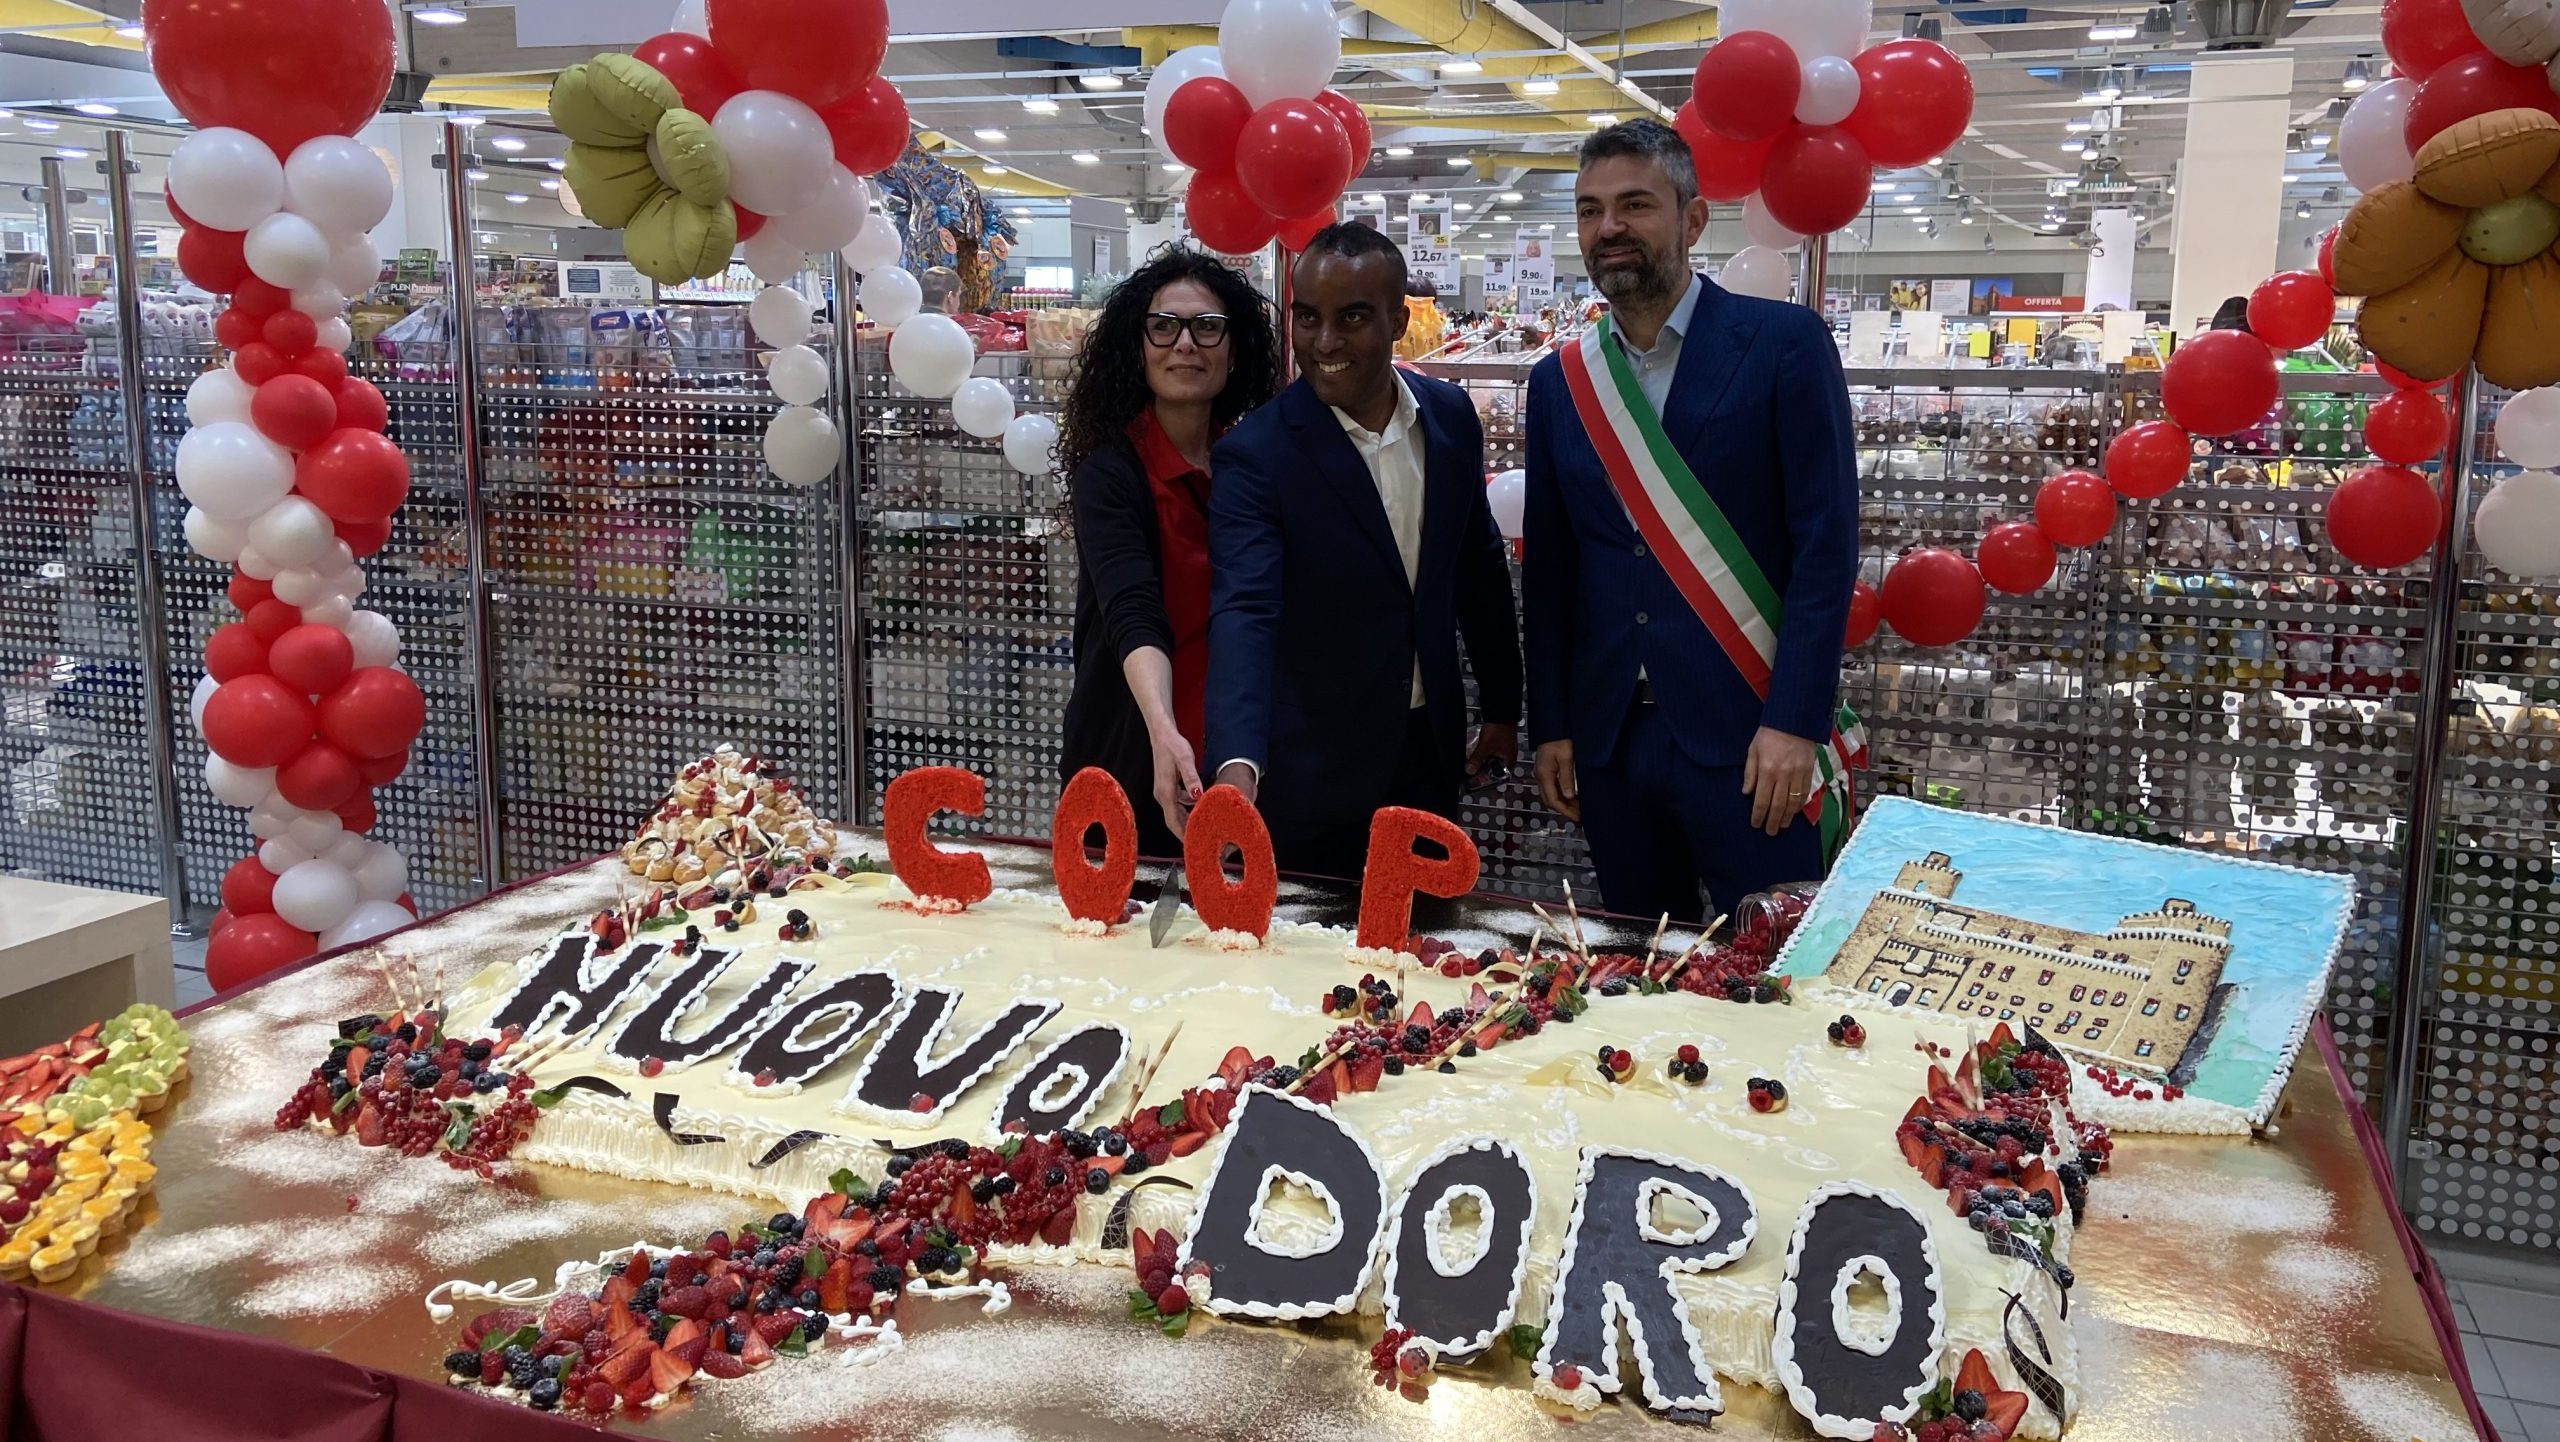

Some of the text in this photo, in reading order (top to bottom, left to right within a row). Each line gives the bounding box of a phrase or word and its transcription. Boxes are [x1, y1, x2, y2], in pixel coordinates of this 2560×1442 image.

[2023, 296, 2062, 307] OFFERTA
[482, 930, 1132, 1144] NUOVO
[1176, 1081, 1945, 1440] DORO
